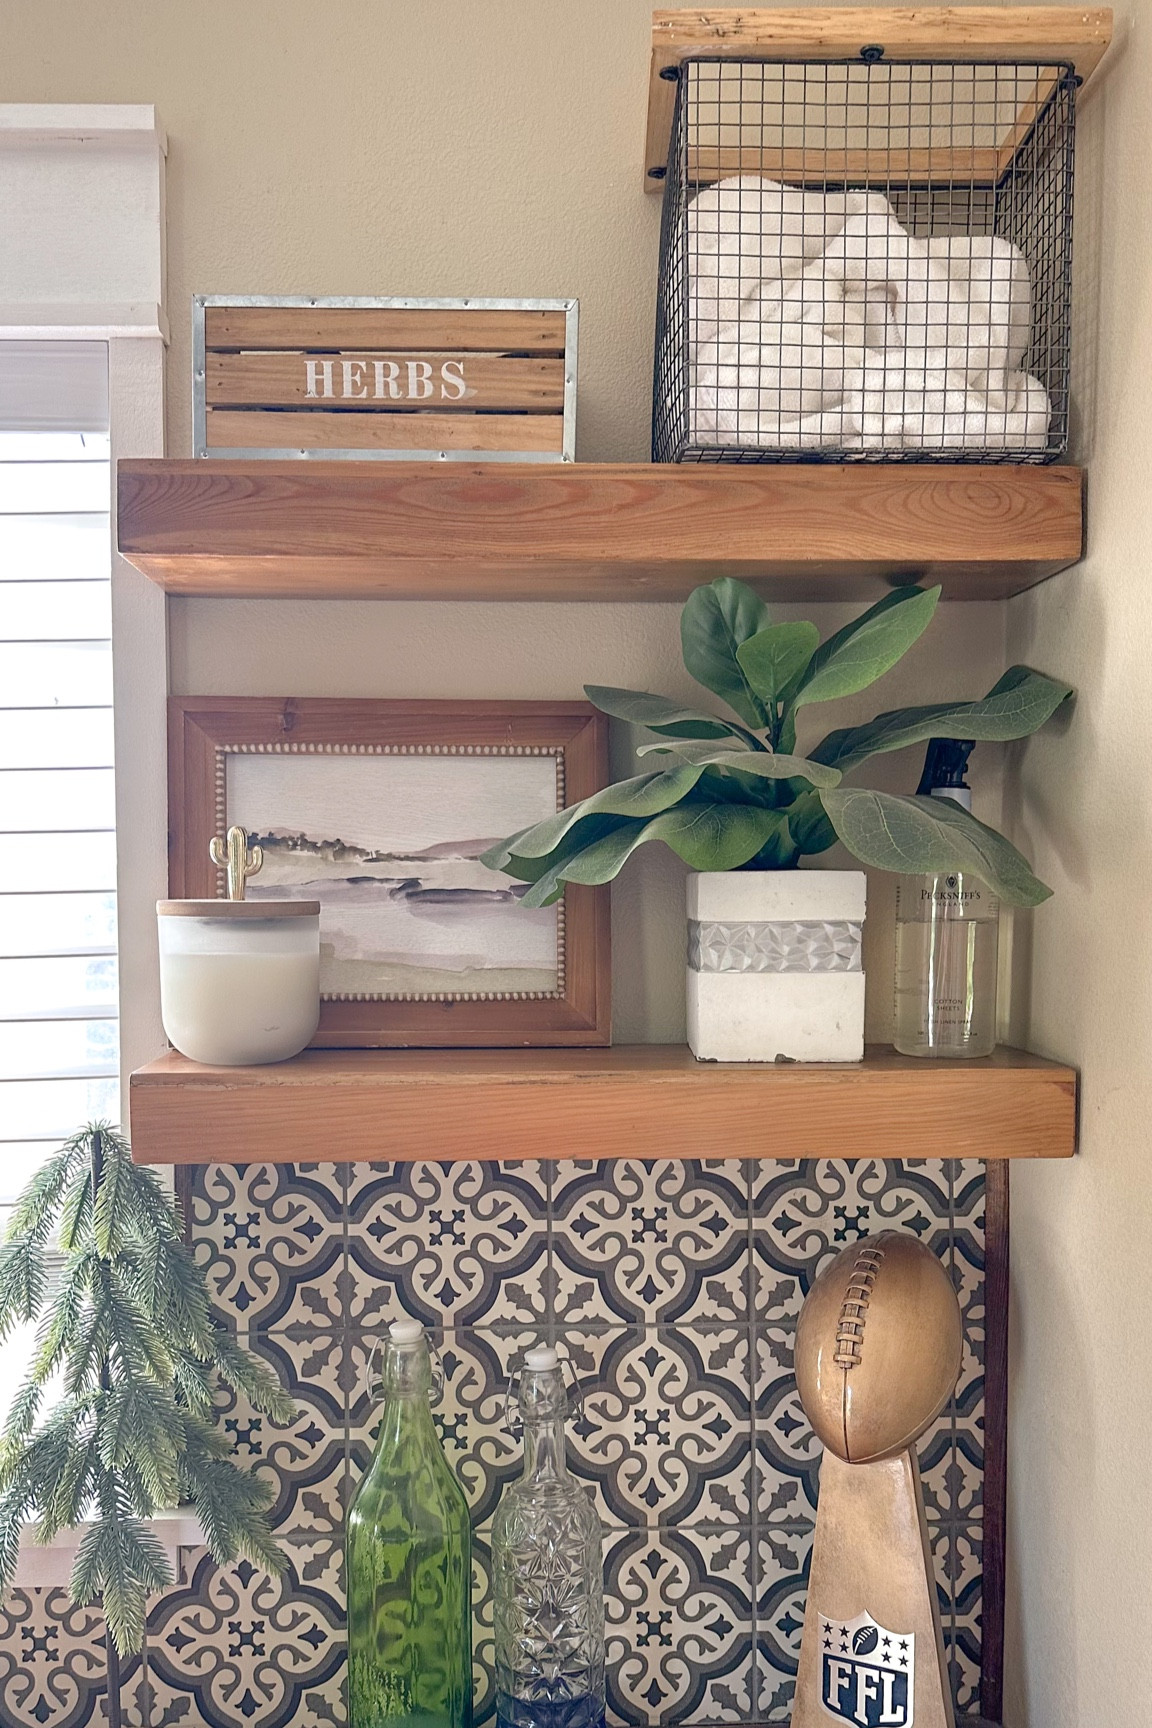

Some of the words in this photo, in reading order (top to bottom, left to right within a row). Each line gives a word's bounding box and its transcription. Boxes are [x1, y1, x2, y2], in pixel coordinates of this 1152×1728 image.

[304, 360, 466, 400] HERBS
[921, 889, 981, 900] PECKSNIFF'S
[827, 1658, 904, 1726] FFL
